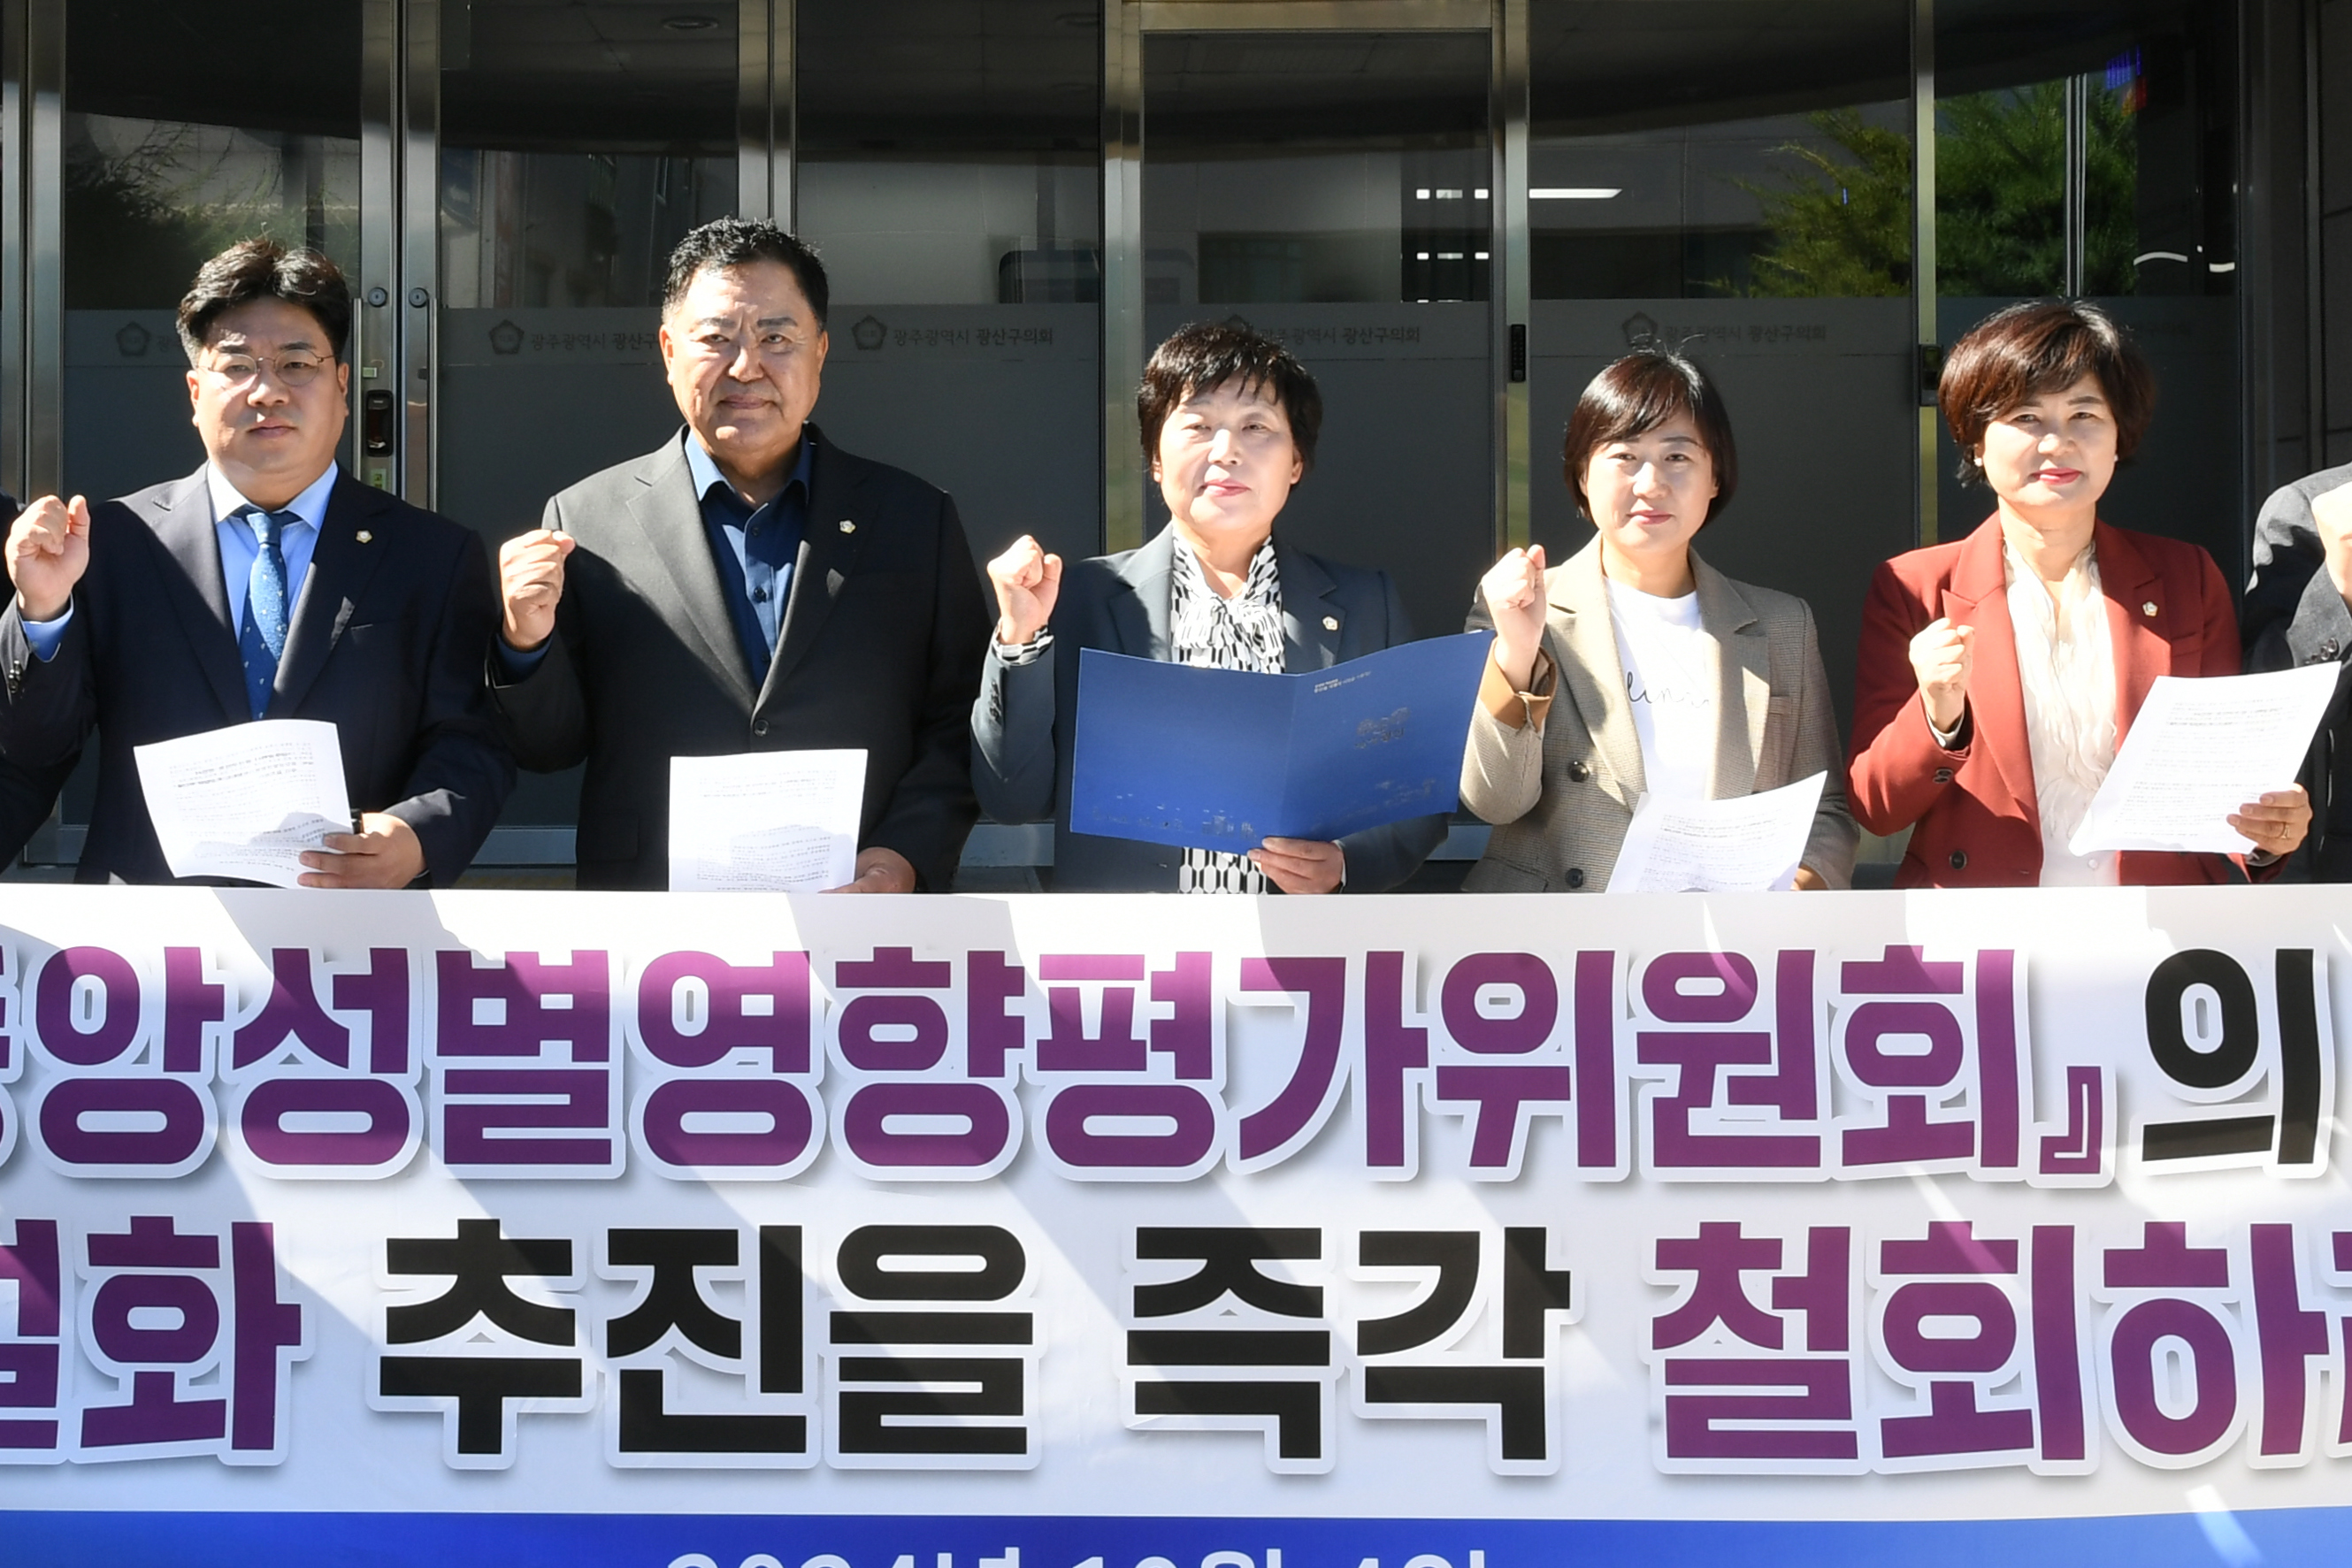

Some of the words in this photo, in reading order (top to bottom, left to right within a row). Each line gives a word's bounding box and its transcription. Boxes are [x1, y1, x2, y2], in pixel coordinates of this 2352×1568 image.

[531, 333, 605, 350] 광주광역시
[612, 333, 658, 350] 광산구
[894, 329, 969, 346] 광주광역시
[977, 328, 1053, 346] 광산구의회
[1344, 326, 1420, 345] 광산구의회
[1748, 325, 1825, 343] 광산구의회
[0, 945, 2102, 1174] 앙성별영향평가위원회』
[2142, 948, 2321, 1164] 의
[380, 1219, 1033, 1454] 추진을
[1127, 1227, 1570, 1459] 즉각
[1652, 1221, 2352, 1460] 철회하
